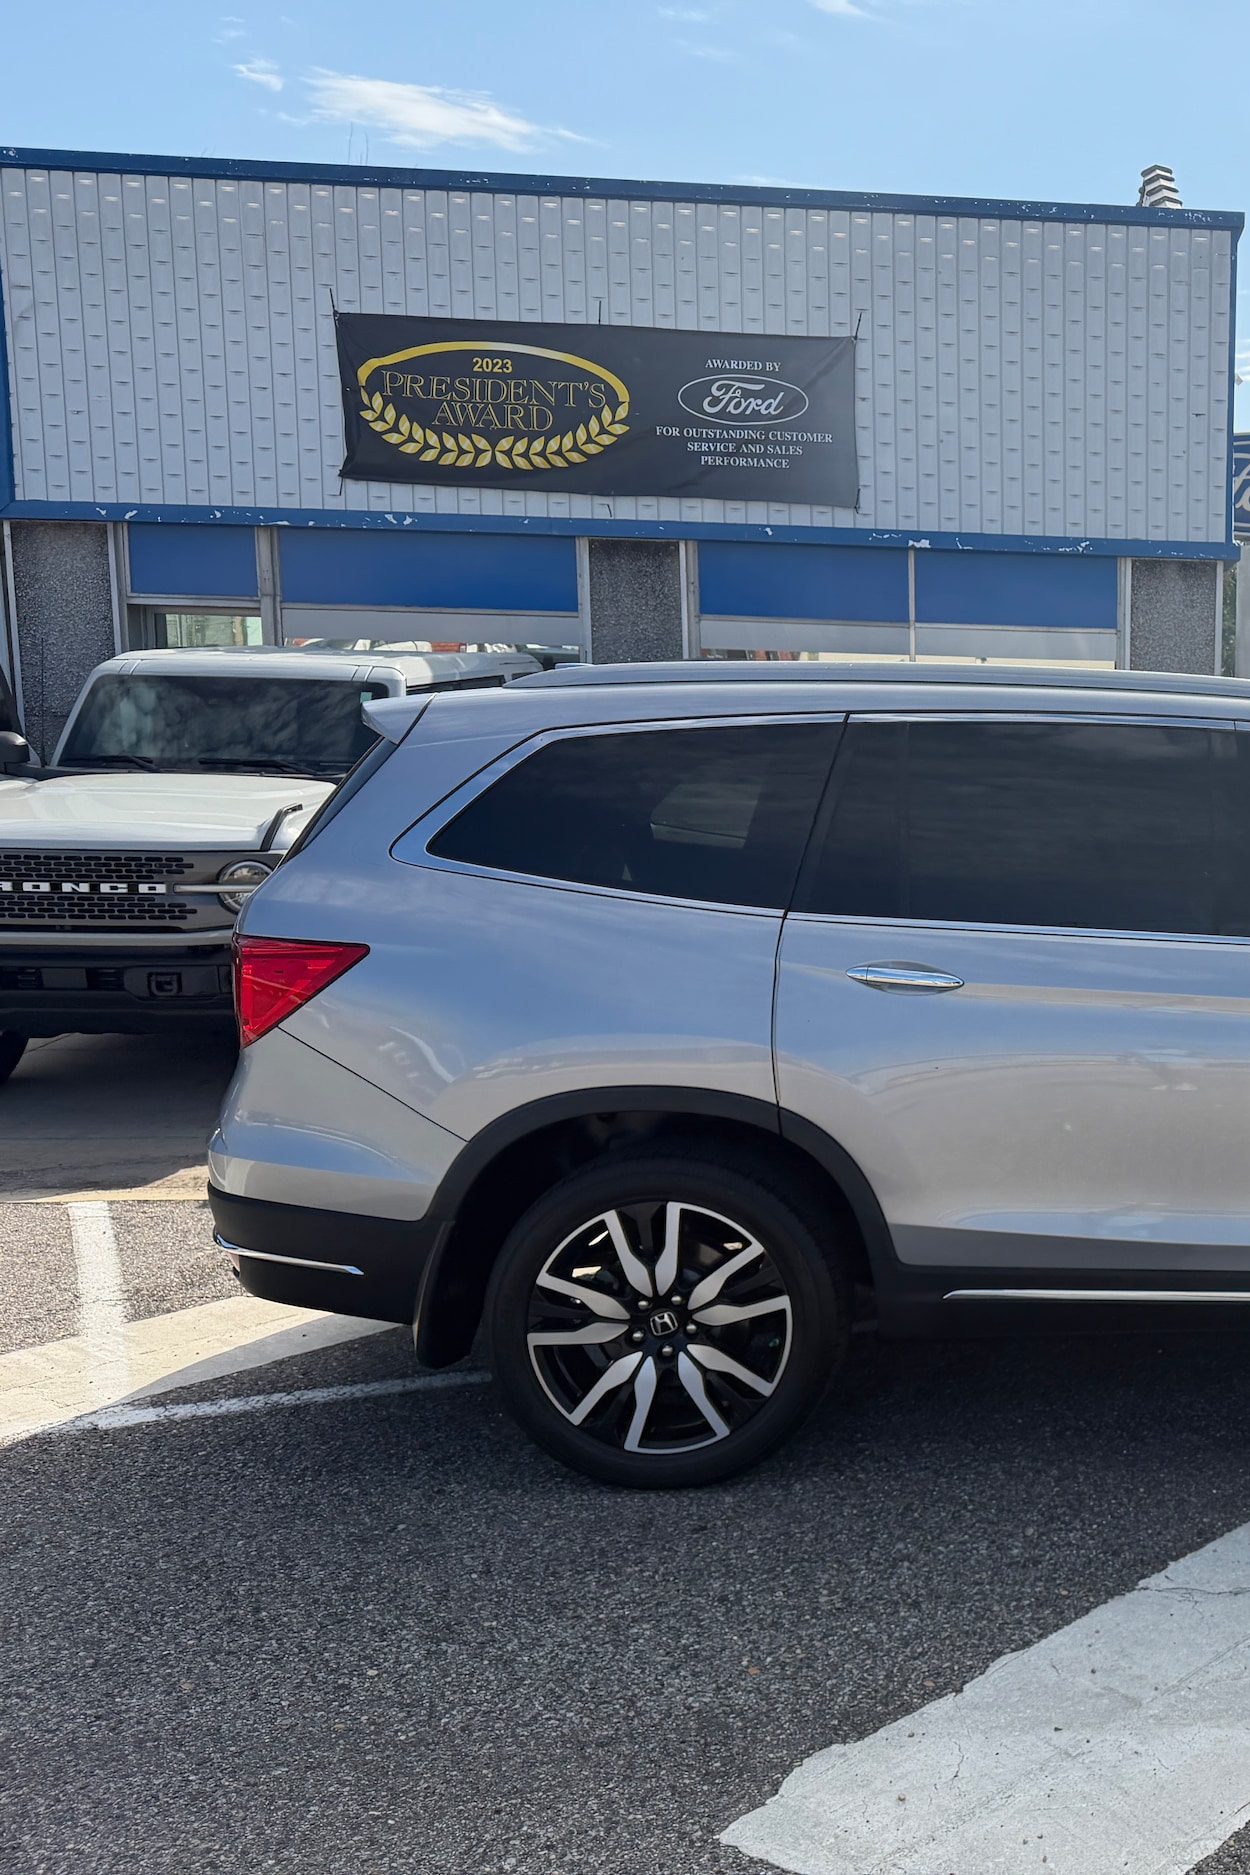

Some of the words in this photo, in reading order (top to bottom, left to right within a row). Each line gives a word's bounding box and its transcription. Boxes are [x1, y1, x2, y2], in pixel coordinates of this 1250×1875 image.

[472, 357, 513, 374] 2023
[705, 359, 762, 371] AWARDED
[766, 361, 781, 372] BY
[381, 370, 606, 409] PRESIDENT'S
[702, 380, 785, 415] Ford
[431, 401, 554, 431] AWARD
[656, 426, 680, 437] FOR
[683, 428, 765, 440] OUTSTANDING
[768, 431, 833, 443] CUSTOMER
[687, 442, 736, 453] SERVICE
[740, 444, 764, 454] AND
[767, 445, 803, 455] SALES
[701, 455, 790, 469] PERFORMANCE
